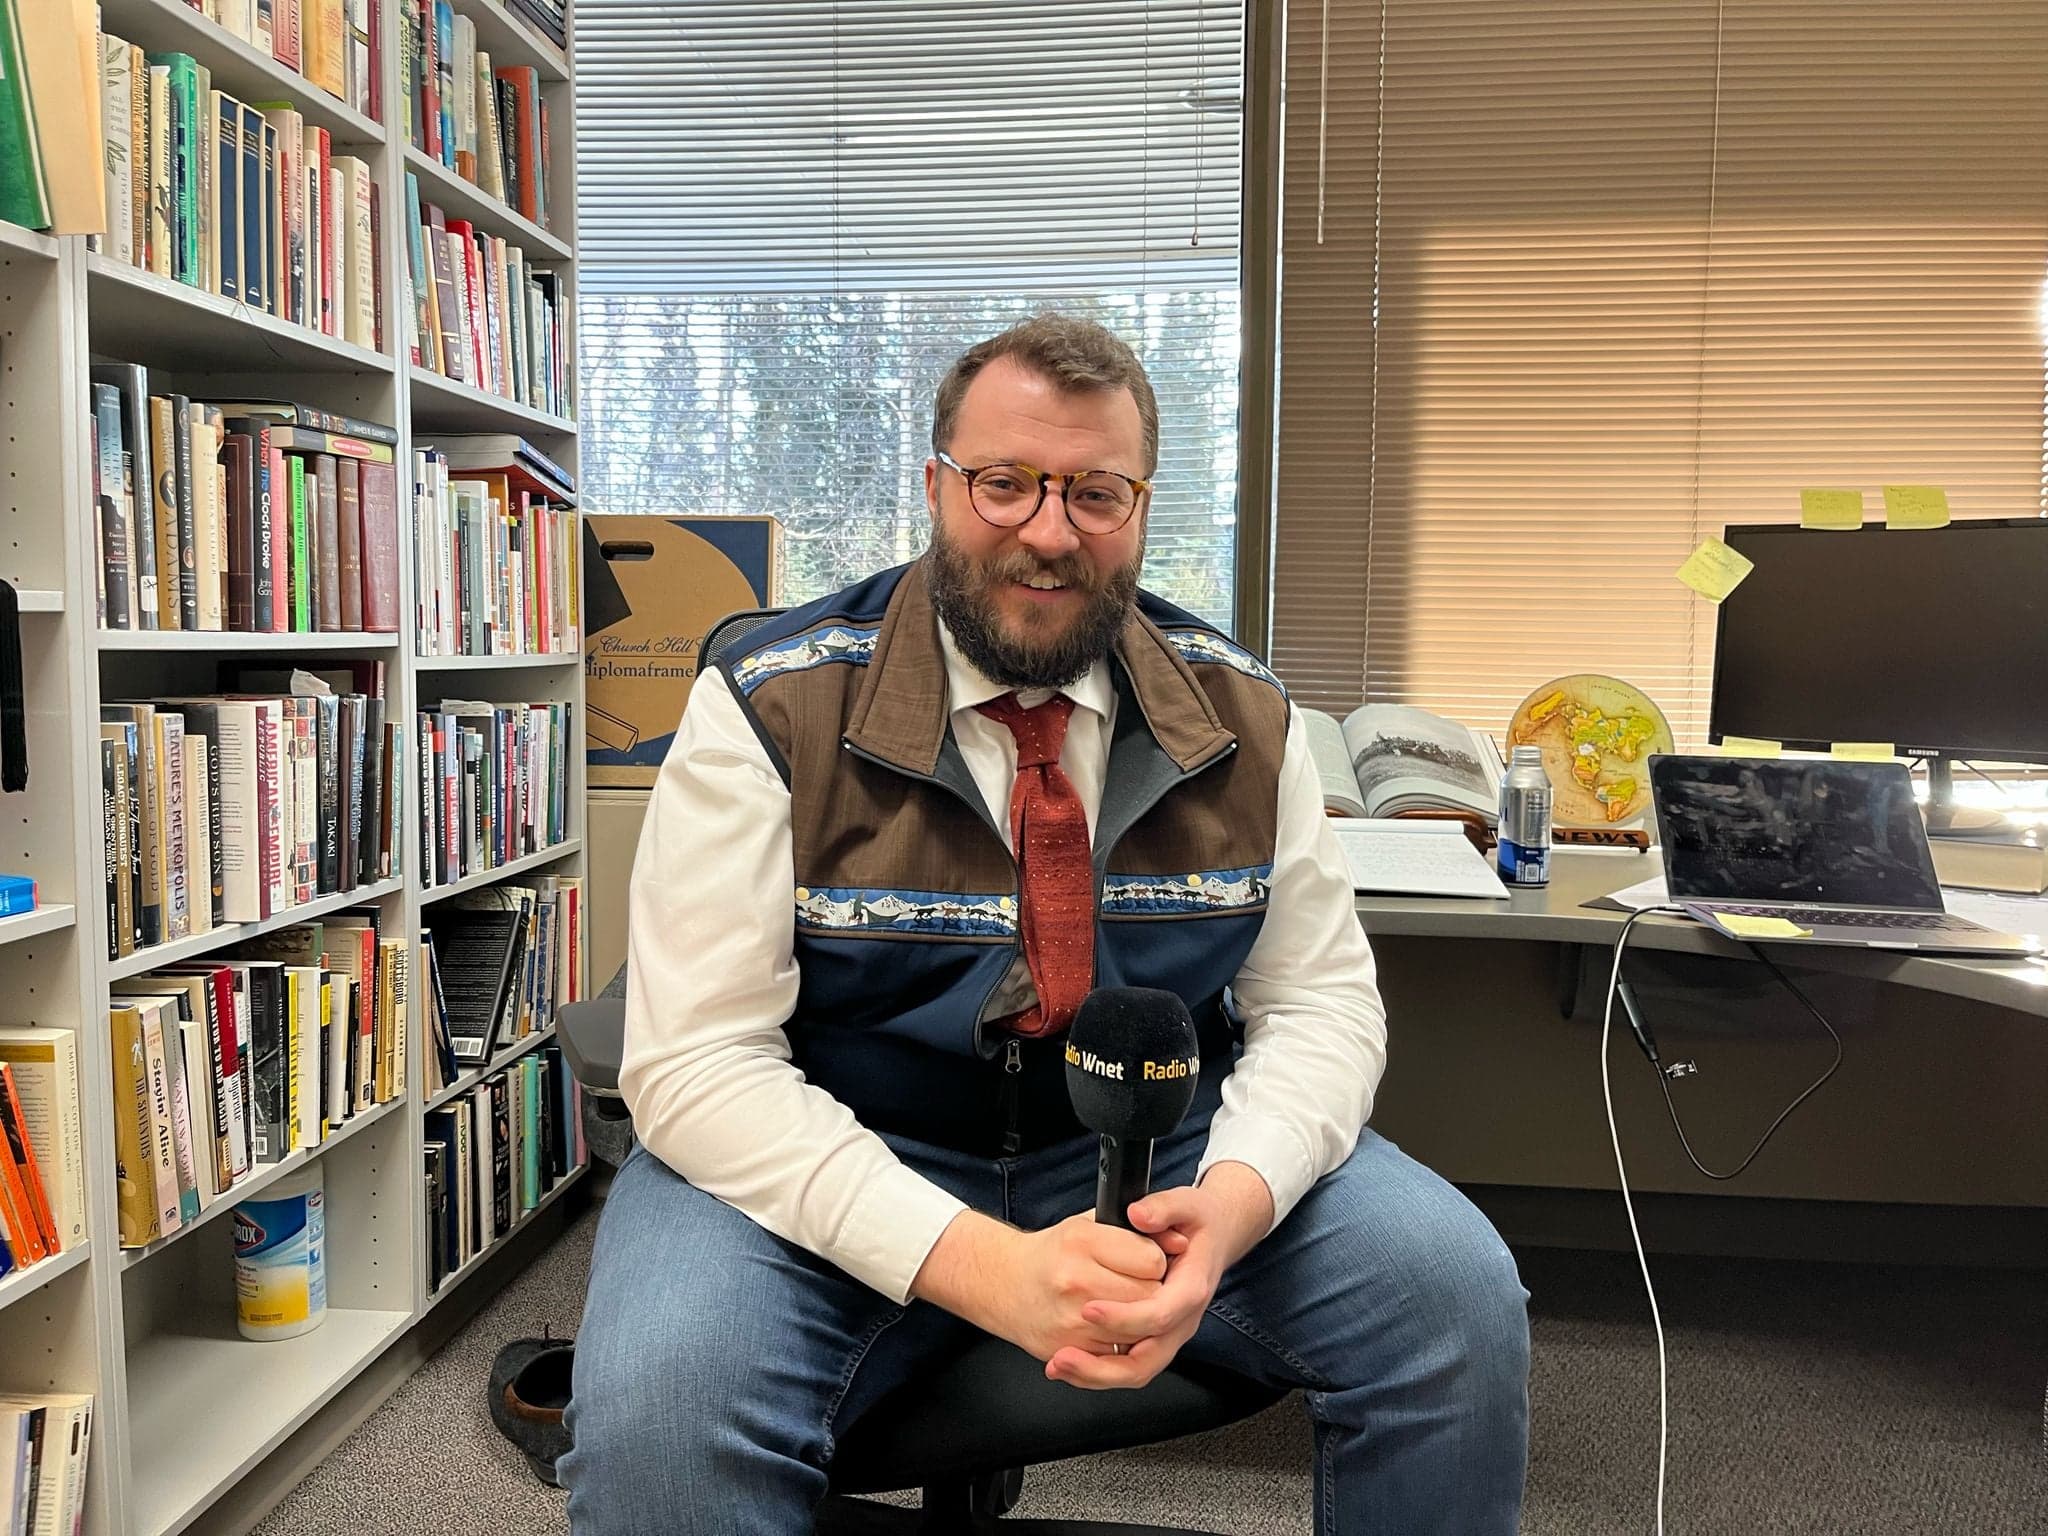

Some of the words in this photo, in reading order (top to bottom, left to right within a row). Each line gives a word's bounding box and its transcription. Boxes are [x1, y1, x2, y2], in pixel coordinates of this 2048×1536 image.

[133, 72, 143, 120] NARRATIVE
[103, 433, 111, 477] SLAVERY
[182, 434, 191, 479] FIRST
[259, 428, 270, 468] When
[259, 469, 270, 491] the
[296, 463, 304, 509] Confederates
[143, 473, 152, 542] LIBRARY
[183, 484, 193, 541] FAMILY
[260, 492, 271, 530] Clock
[296, 522, 304, 533] the
[165, 511, 178, 609] ADAMS
[261, 530, 272, 569] Broke
[296, 536, 304, 553] Attic
[600, 635, 651, 654] Church
[653, 636, 694, 654] Hill
[585, 659, 694, 681] diplomaframe
[170, 729, 183, 804] NATURE'S
[197, 740, 206, 783] ORDEAL
[209, 745, 219, 797] GOD'S
[257, 718, 266, 783] REPUBLIC
[266, 720, 280, 808] AMERICAN
[1908, 749, 1940, 757] SAMSUNG
[116, 763, 126, 804] LEGACY
[147, 782, 156, 812] AGE
[450, 778, 458, 799] RED
[104, 788, 113, 840] AMERICAN
[149, 820, 157, 839] OF
[199, 795, 207, 839] HUNGER
[211, 801, 221, 836] RED
[350, 806, 360, 841] Ghosts
[450, 800, 458, 855] LEVIATHAN
[118, 812, 128, 867] CONQUEST
[212, 840, 223, 875] SON
[269, 825, 282, 889] EMPIRE
[327, 816, 337, 858] TAKAKI
[105, 841, 114, 884] HISTORY
[150, 845, 159, 892] GOLD
[171, 810, 185, 910] METROPOLIS
[208, 981, 215, 991] A
[395, 949, 404, 1005] SCOTTSBORO
[209, 994, 222, 1045] TRAITOR
[68, 1044, 76, 1082] EMPIRE
[213, 1048, 223, 1061] TO
[215, 1066, 225, 1084] HIS
[1065, 1041, 1081, 1067] dio
[1082, 1050, 1124, 1081] Wnet
[1143, 1059, 1187, 1080] Radio
[135, 1076, 146, 1099] THE
[153, 1057, 168, 1119] Stayin'
[173, 1077, 184, 1105] GAY
[228, 1072, 241, 1121] Cigarette
[239, 1056, 248, 1104] REFORM
[71, 1105, 79, 1151] COTTON
[136, 1101, 151, 1160] SEVENTIES
[176, 1109, 188, 1139] NEW
[216, 1088, 228, 1132] SPECIES
[157, 1123, 170, 1168] Alive
[179, 1145, 192, 1186] YORK
[235, 1224, 257, 1243] ROX
